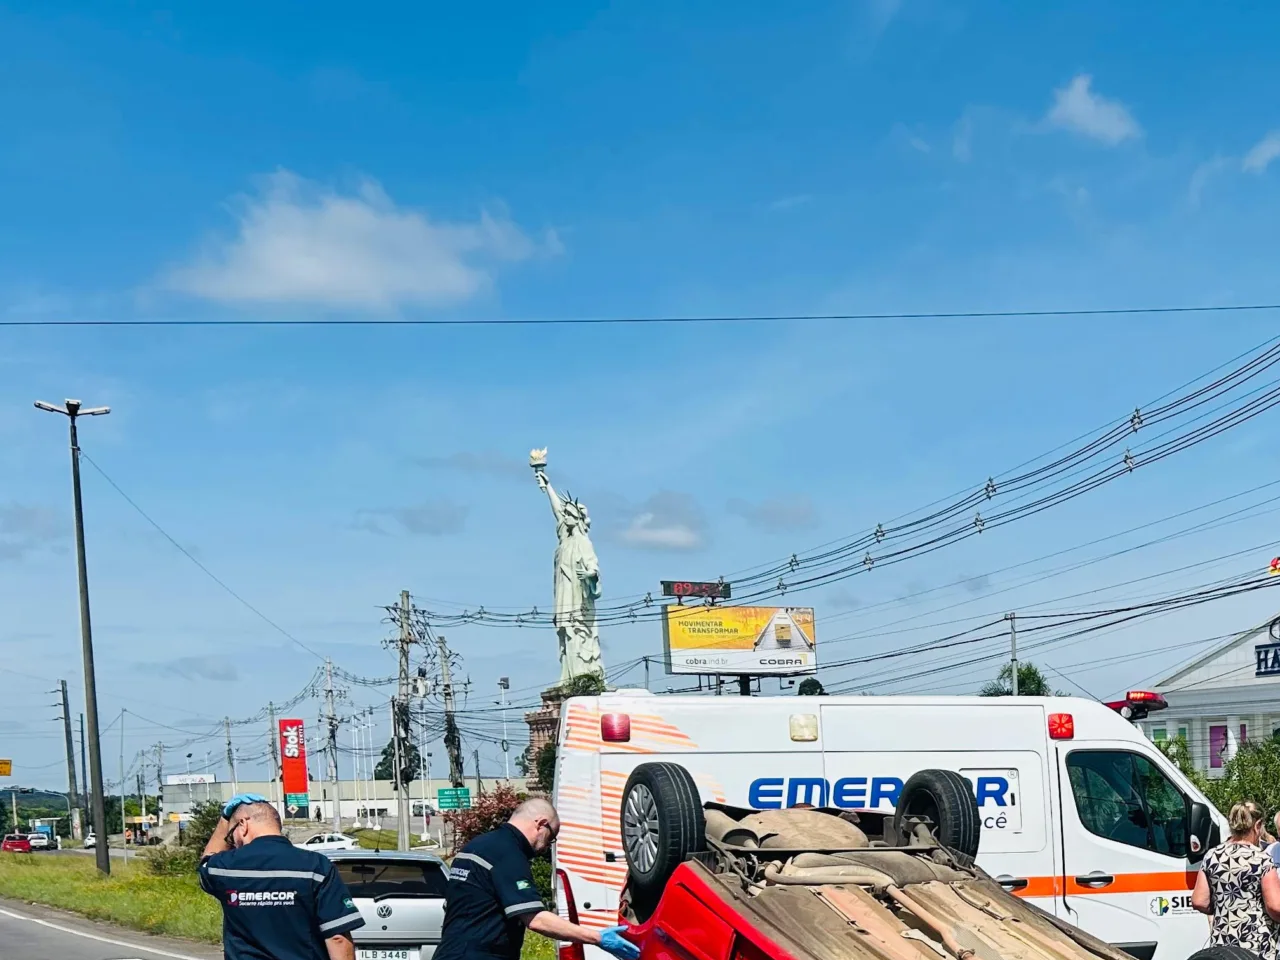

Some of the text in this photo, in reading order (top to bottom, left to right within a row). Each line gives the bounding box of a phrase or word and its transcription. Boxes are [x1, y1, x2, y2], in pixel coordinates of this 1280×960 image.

[283, 725, 299, 758] Stok
[748, 776, 1009, 809] EMERR
[238, 891, 295, 901] EMERCOR
